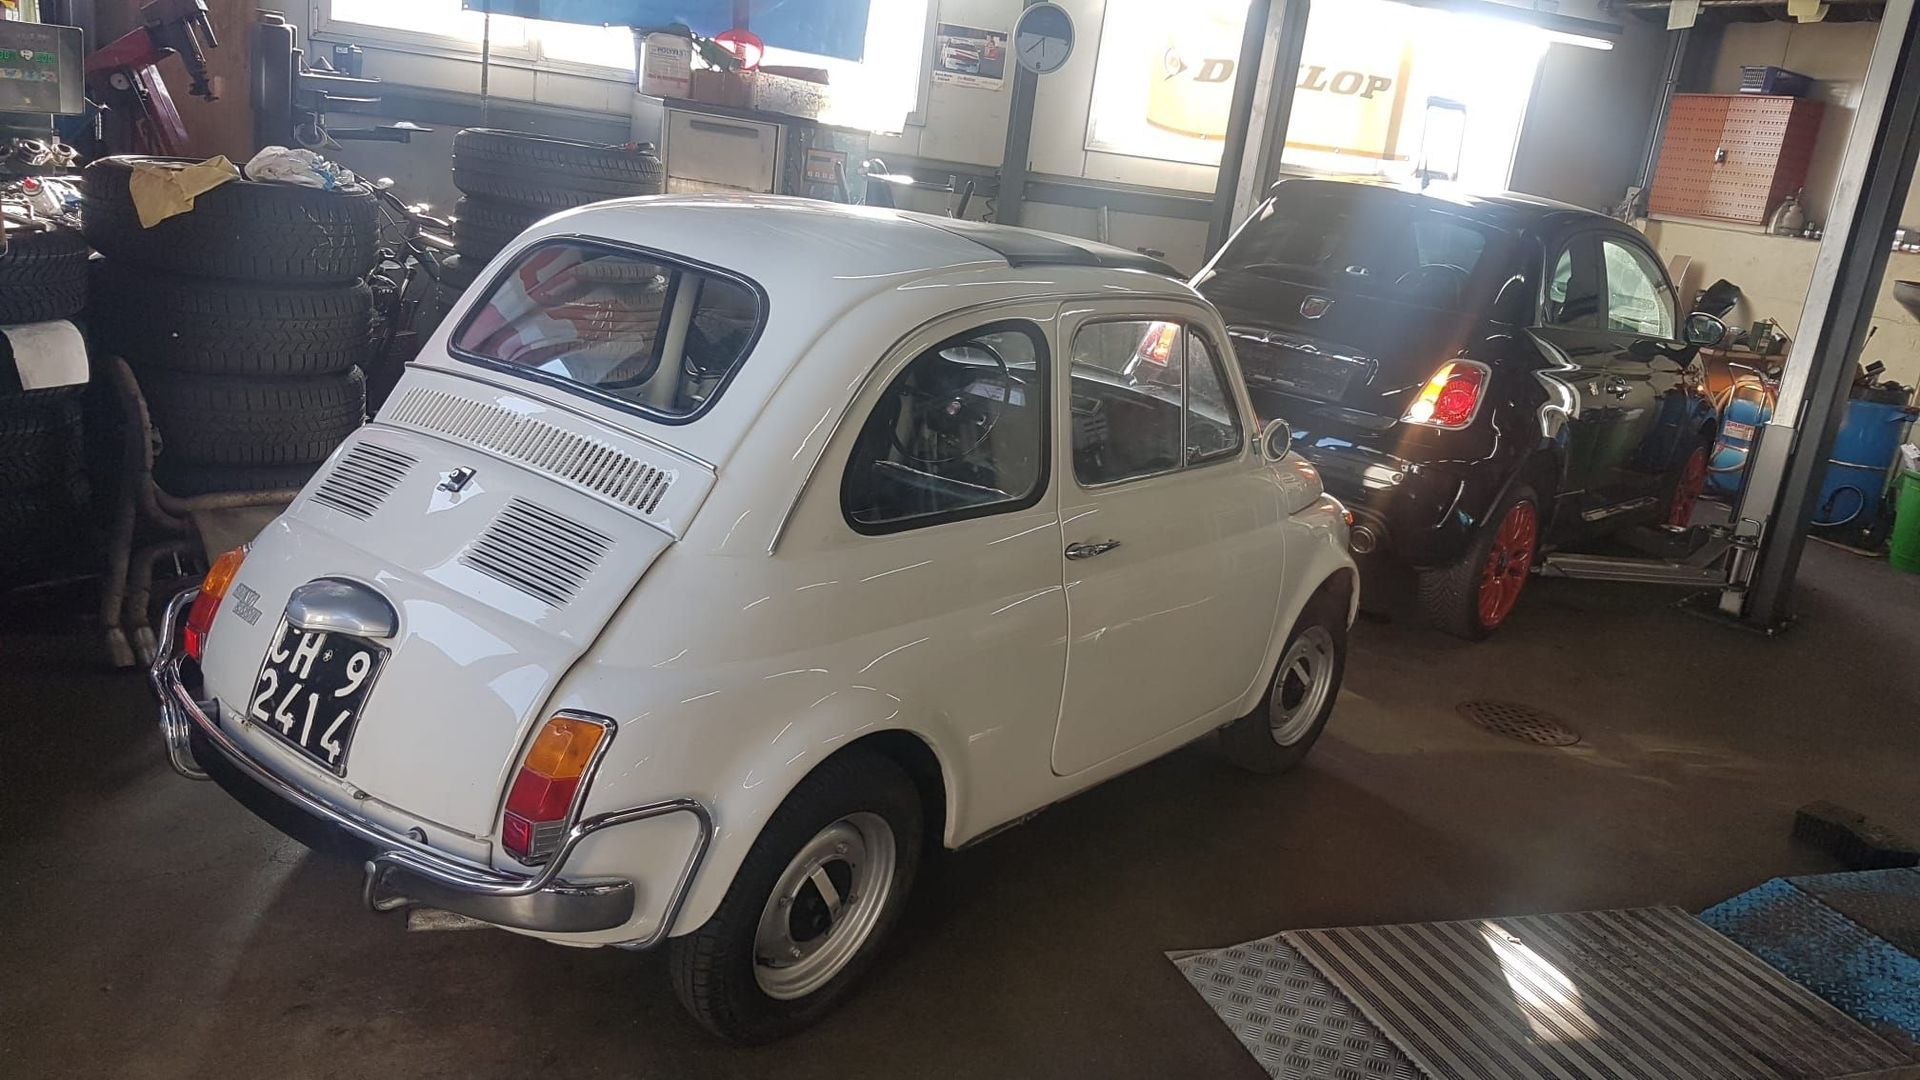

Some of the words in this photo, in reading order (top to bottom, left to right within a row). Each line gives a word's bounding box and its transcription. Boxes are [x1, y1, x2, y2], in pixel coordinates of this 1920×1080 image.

[1193, 58, 1392, 99] DLOP
[271, 620, 327, 680] CH
[334, 650, 371, 698] 9
[252, 667, 351, 764] 2414
